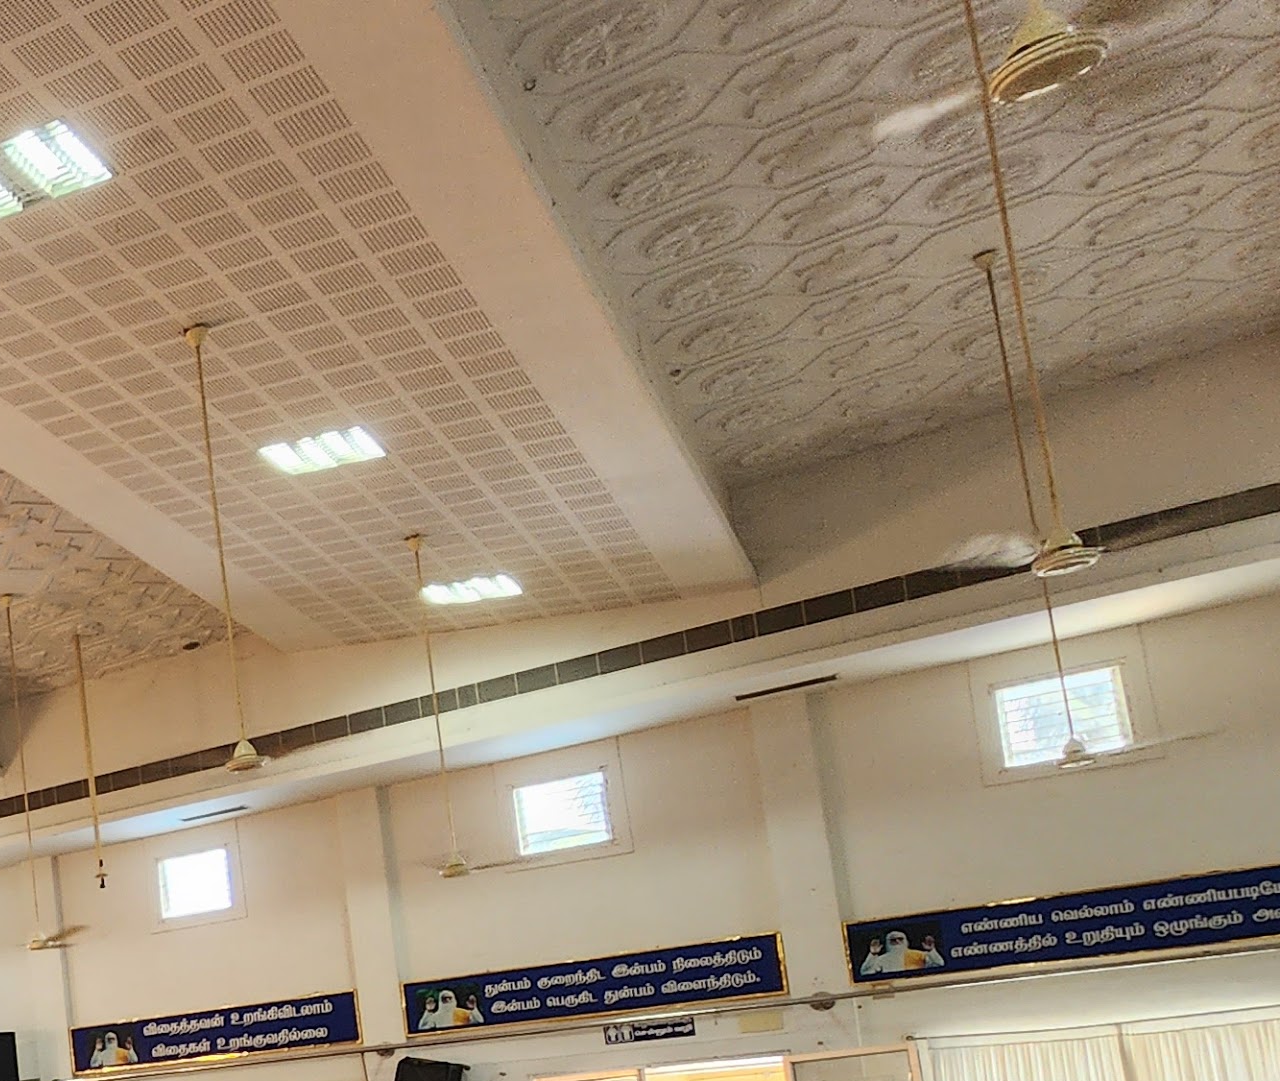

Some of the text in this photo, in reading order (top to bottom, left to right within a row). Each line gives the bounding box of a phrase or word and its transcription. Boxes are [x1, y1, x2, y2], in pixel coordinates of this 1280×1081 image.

[949, 932, 1059, 959] எண்ணத்தில்
[1065, 921, 1146, 947] உறுதியும்
[1152, 909, 1244, 938] ஒழுங்கும்
[960, 913, 1044, 935] எண்ணிய
[1050, 898, 1136, 923] வெல்லாம்
[484, 946, 763, 998] துன்பம் குறைந்திட இன்பம் நிலைத்திடும்
[490, 996, 542, 1014] இன்பம்
[546, 990, 599, 1008] பெருகிட
[604, 982, 656, 1005] துன்பம்
[143, 999, 334, 1037] விதைத்தவன் உறங்கிவிடலாம்
[151, 1025, 329, 1059] விதைகள் உறங்குவதில்லை
